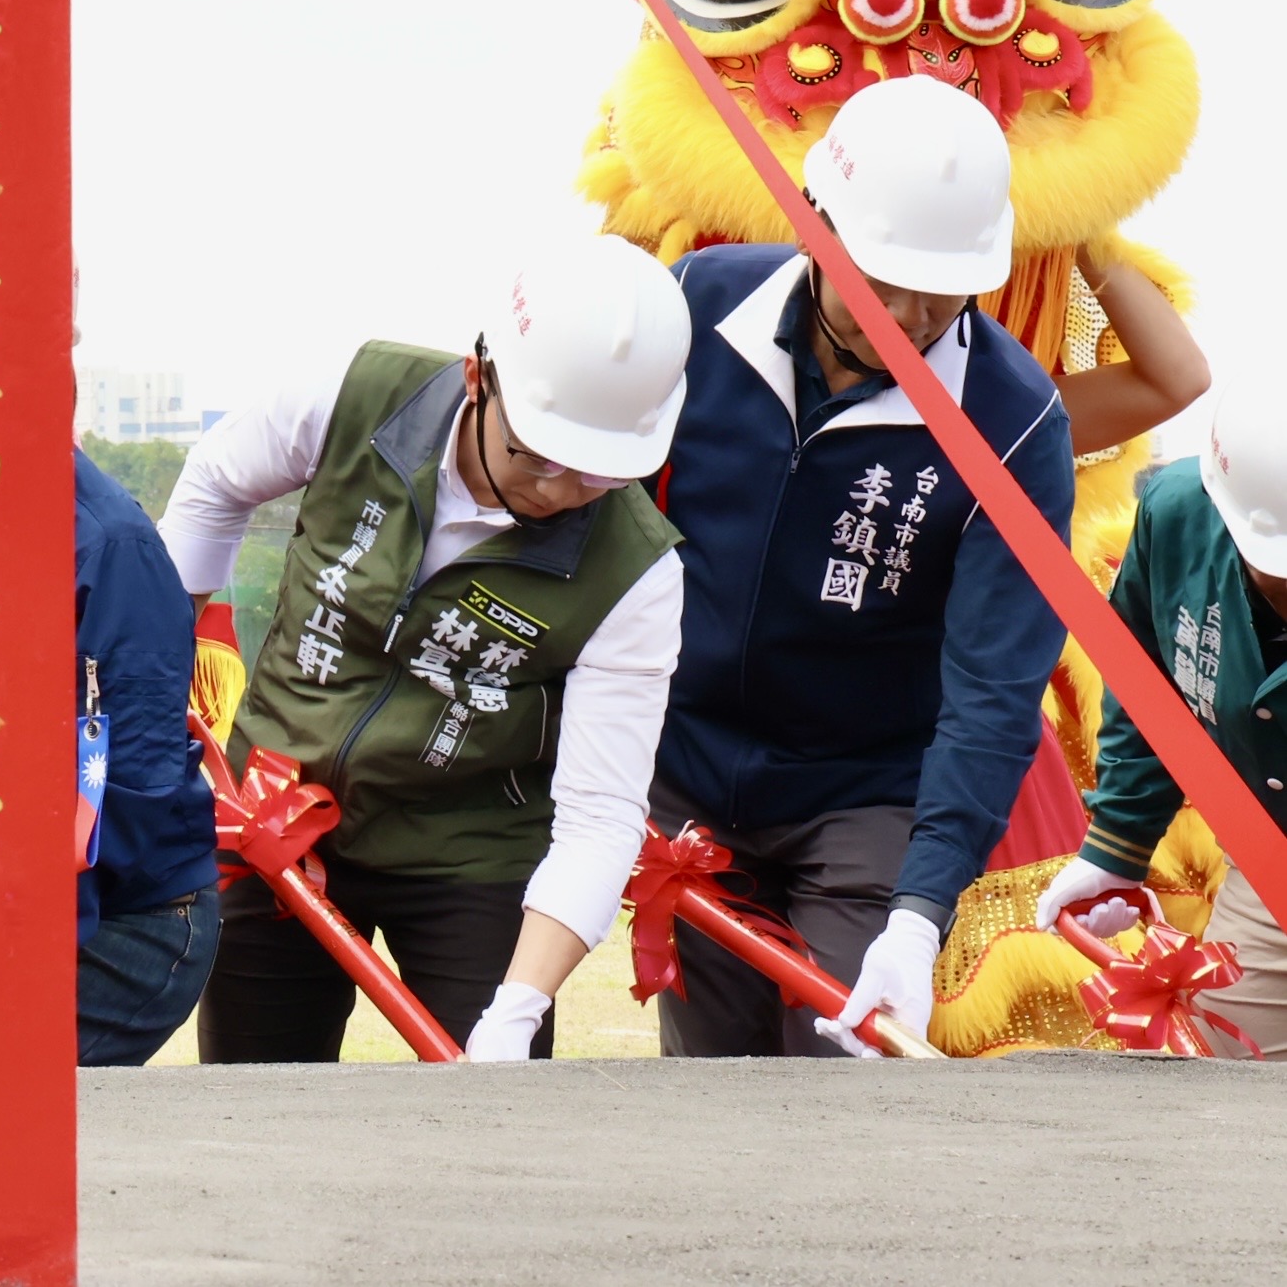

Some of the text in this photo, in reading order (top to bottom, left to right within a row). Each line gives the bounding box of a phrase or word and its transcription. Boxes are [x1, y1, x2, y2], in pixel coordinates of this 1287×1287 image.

[338, 498, 387, 572] 市議員
[820, 463, 893, 612] 李鎮國
[877, 465, 940, 597] 台南市議員
[486, 601, 539, 638] DPP
[1196, 601, 1222, 726] 台南市議員
[424, 700, 470, 768] 聯合團隊
